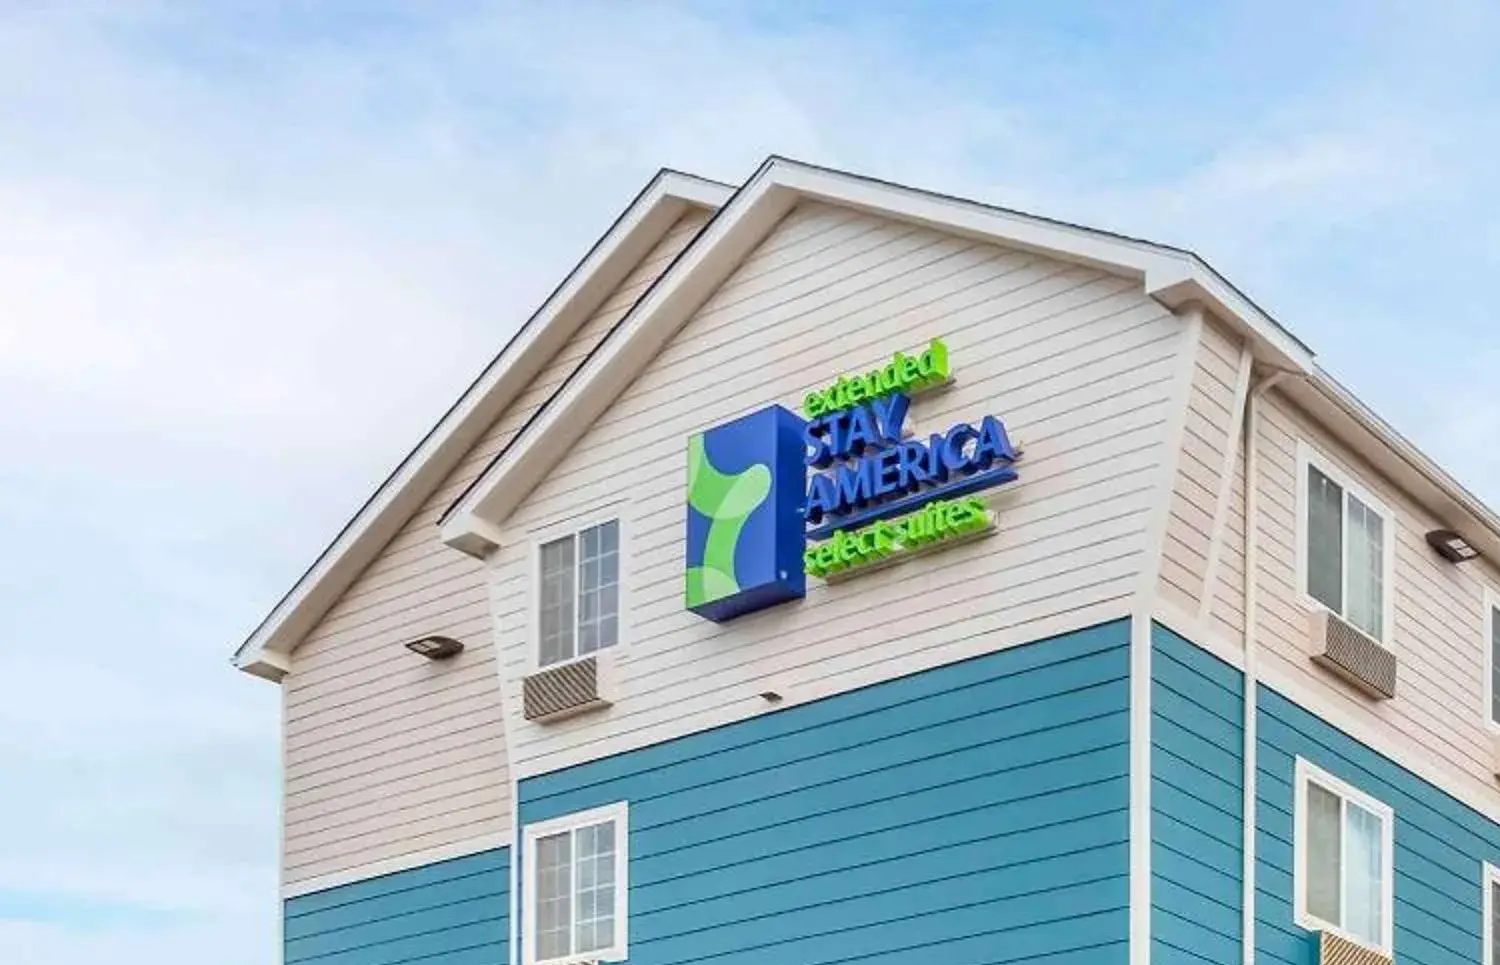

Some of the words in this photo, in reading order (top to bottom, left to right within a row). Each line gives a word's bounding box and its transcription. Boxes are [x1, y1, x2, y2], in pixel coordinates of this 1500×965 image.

[803, 336, 949, 418] extended
[804, 393, 911, 468] STAY
[805, 414, 1017, 524] AMERICA
[803, 521, 897, 577] select
[896, 496, 991, 550] suites
